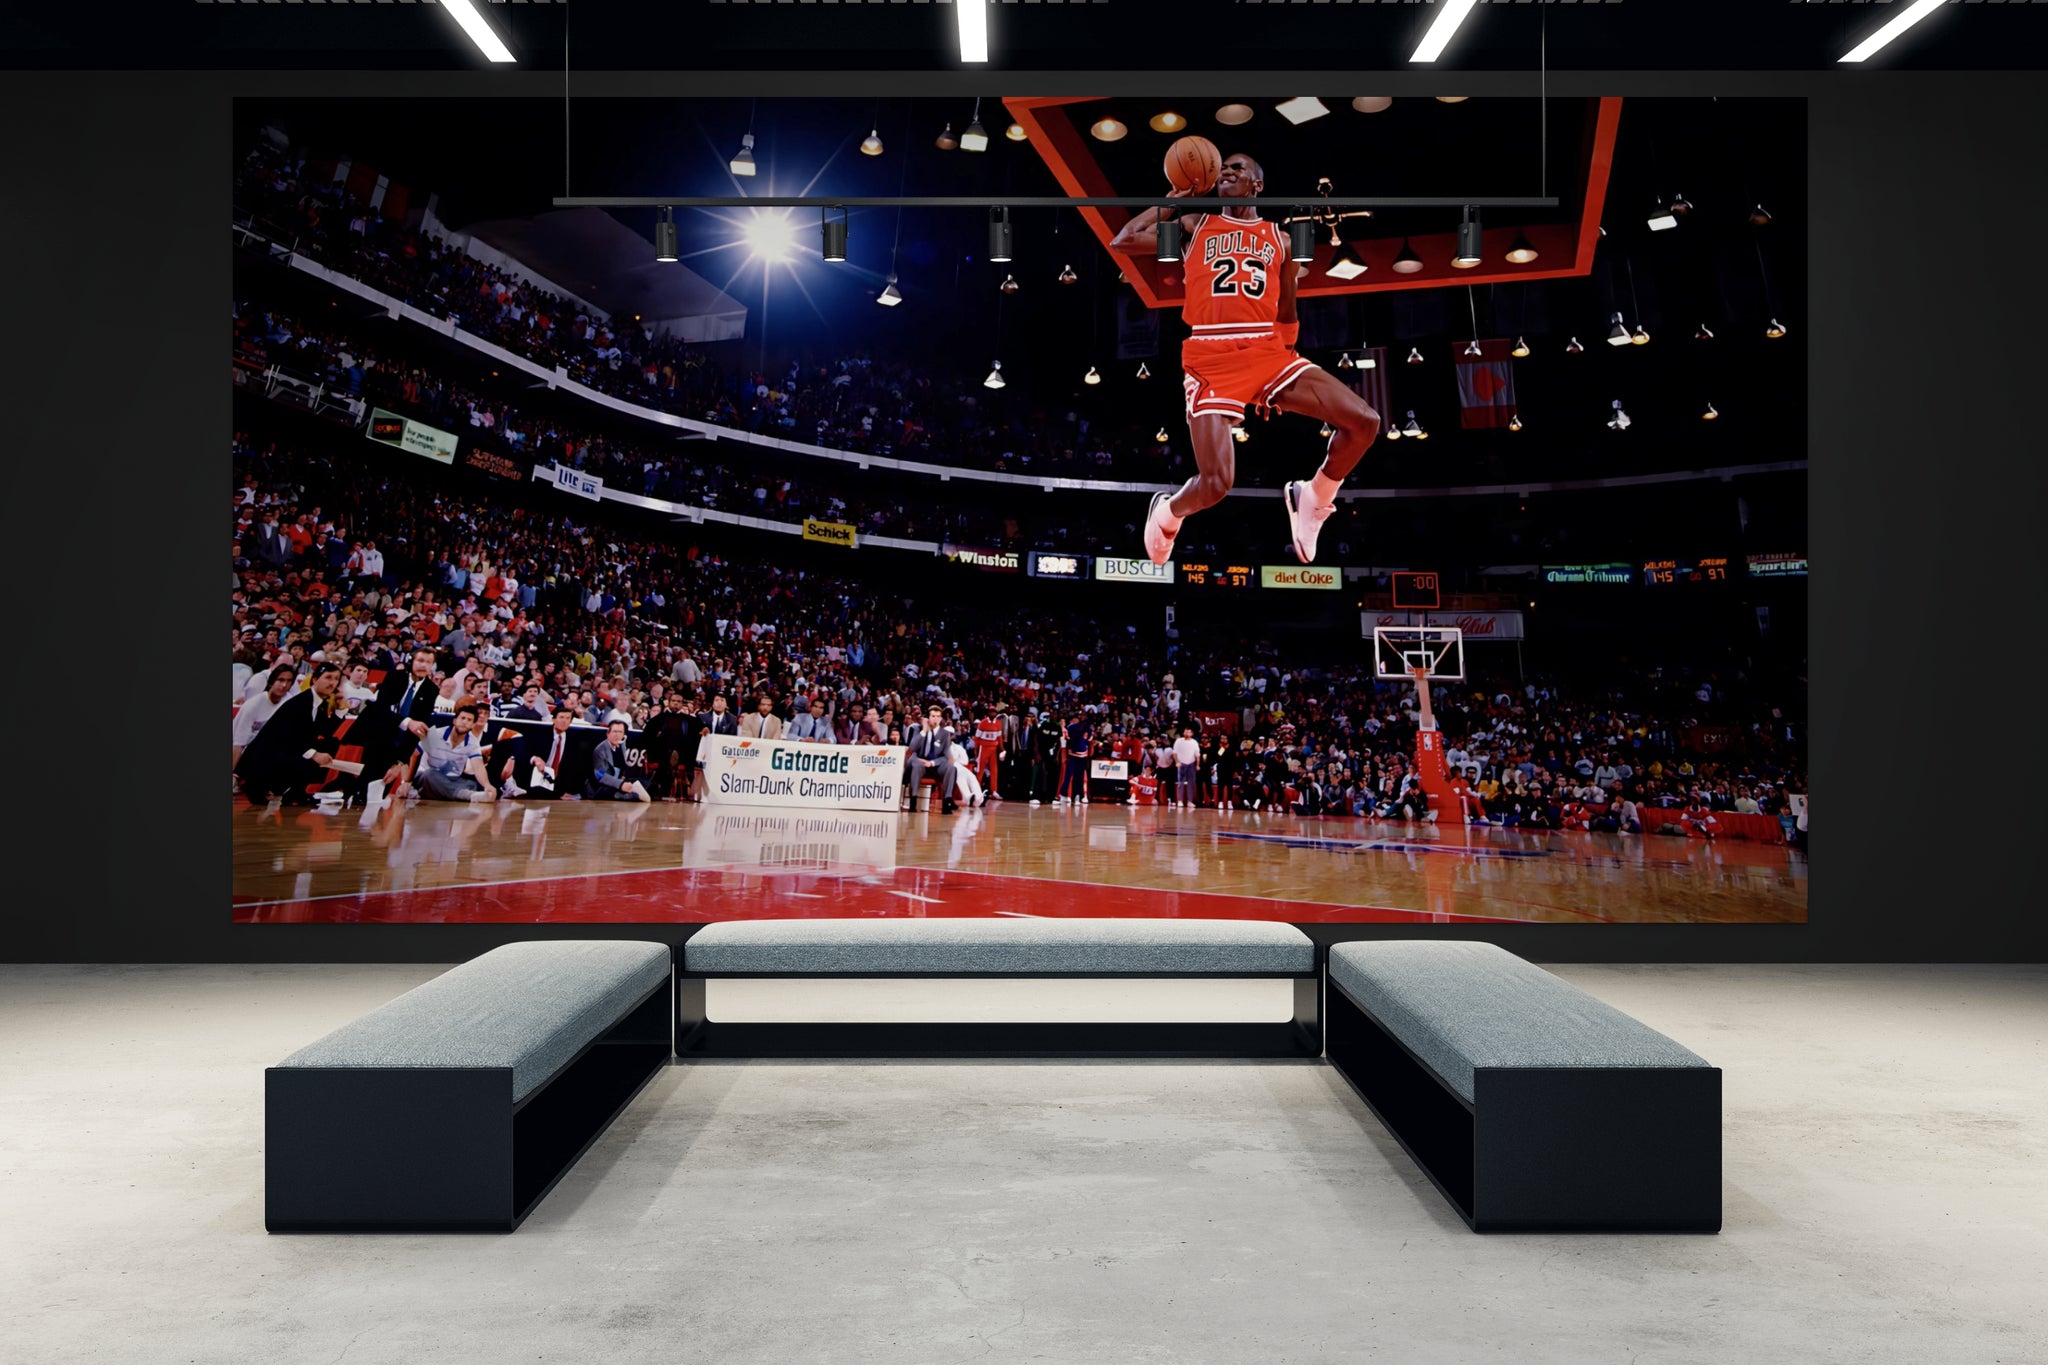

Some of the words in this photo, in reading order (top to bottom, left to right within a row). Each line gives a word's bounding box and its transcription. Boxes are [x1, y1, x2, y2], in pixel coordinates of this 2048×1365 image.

[1204, 230, 1275, 265] BULLS
[1212, 257, 1267, 299] 23
[559, 468, 579, 487] Lite
[807, 523, 850, 541] Schick
[959, 550, 1018, 568] Winston
[1104, 560, 1165, 577] BUSCH
[1707, 568, 1726, 580] 97
[1188, 572, 1205, 584] 145
[1232, 575, 1247, 586] 97
[1274, 571, 1297, 583] diet
[1300, 570, 1334, 585] Coke
[1653, 571, 1674, 584] 145
[721, 745, 760, 758] Gatorade
[771, 747, 848, 774] Gatorade
[720, 772, 794, 797] Slam-Dunk
[800, 777, 892, 803] Championship
